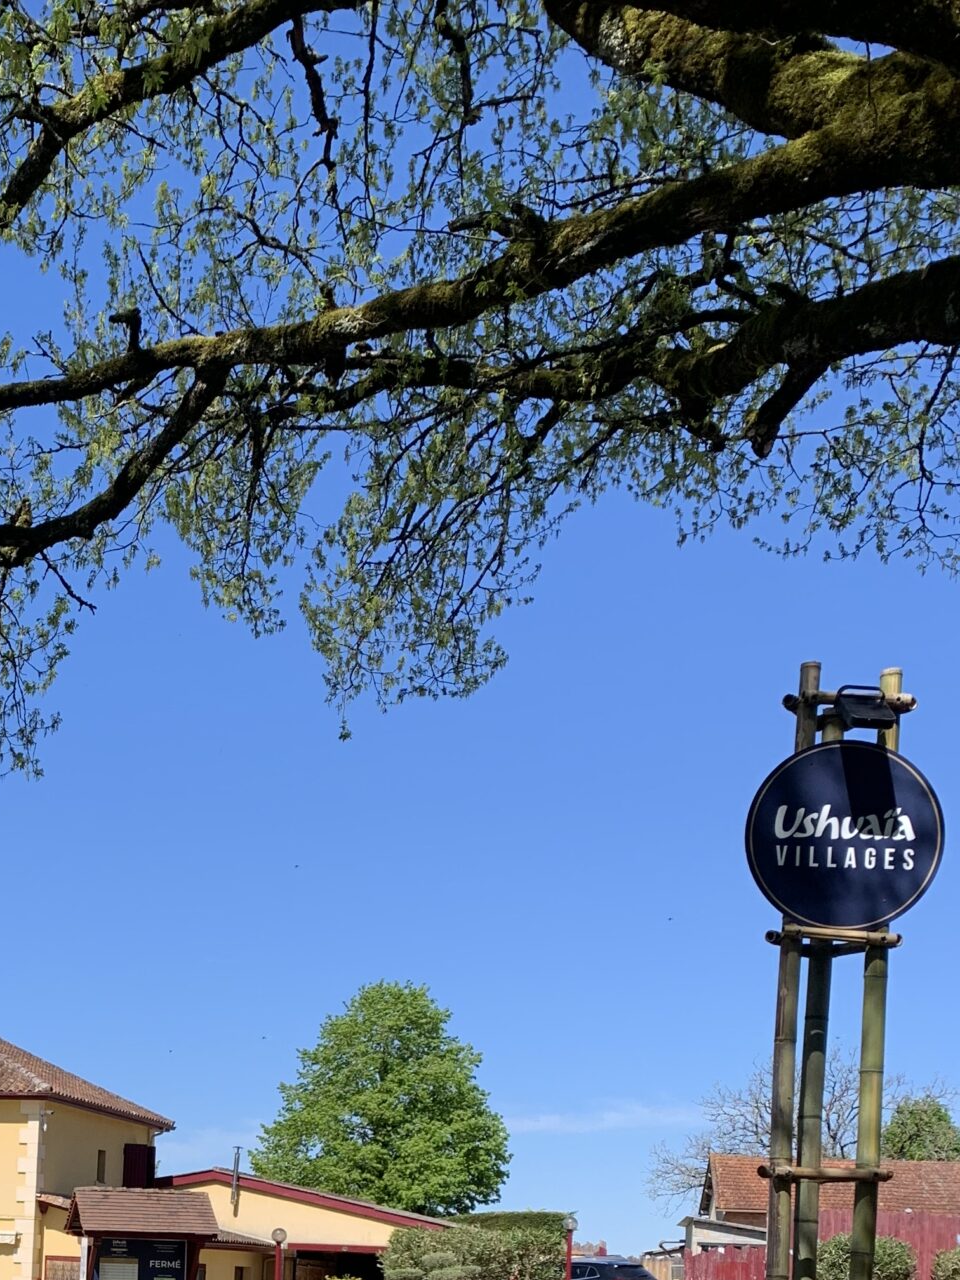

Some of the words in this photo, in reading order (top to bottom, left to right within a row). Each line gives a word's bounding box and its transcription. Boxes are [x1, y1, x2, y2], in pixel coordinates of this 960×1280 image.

[774, 804, 916, 842] Ushuaïa
[775, 845, 915, 871] VILLAGES
[149, 1259, 182, 1269] FERMÉ
